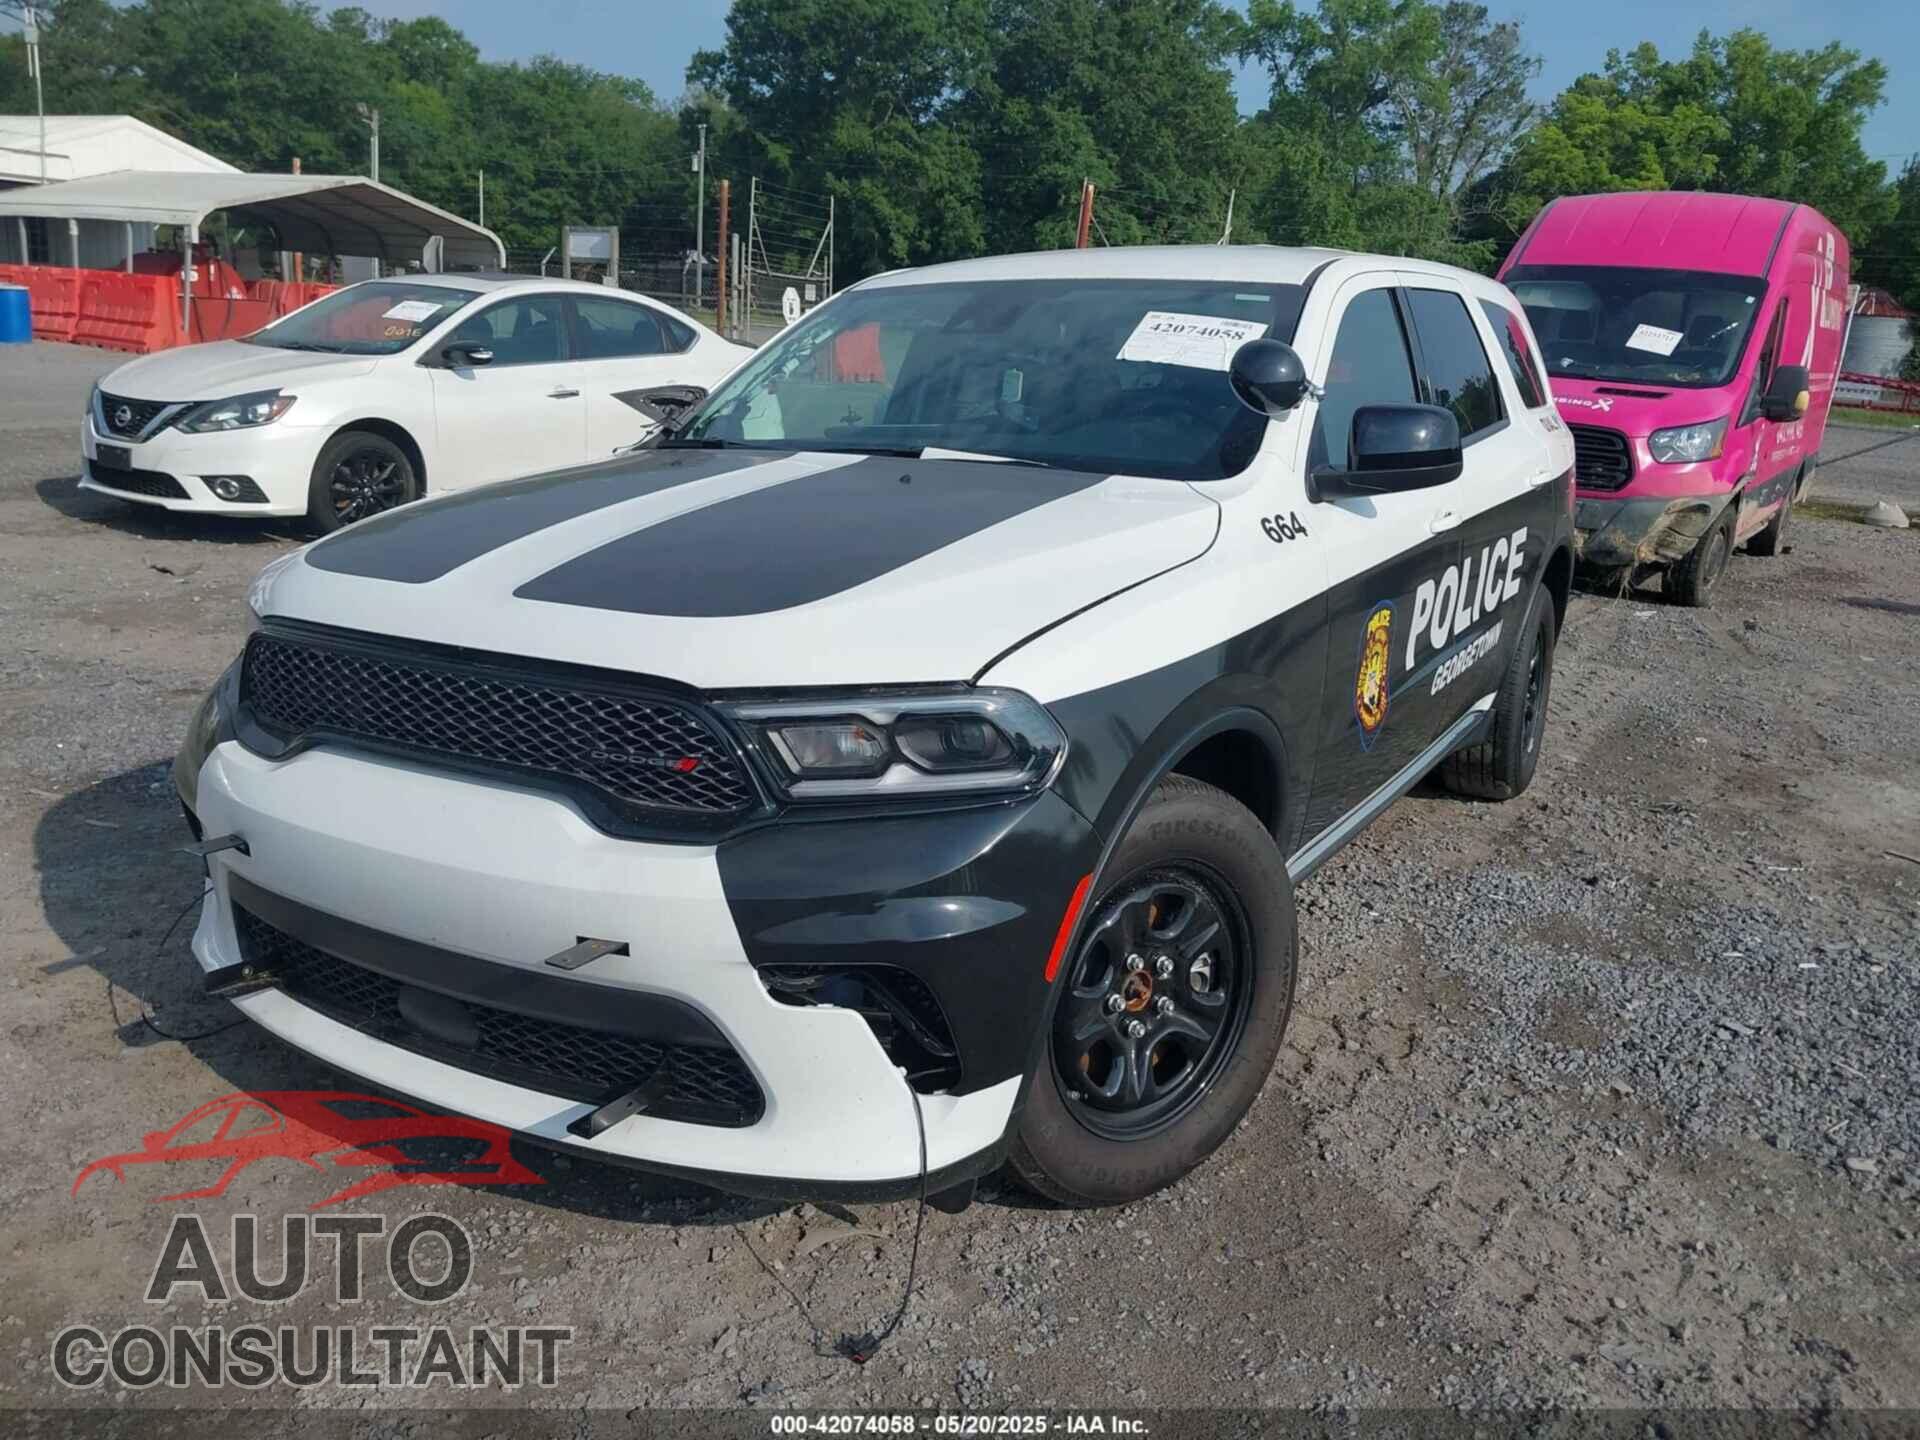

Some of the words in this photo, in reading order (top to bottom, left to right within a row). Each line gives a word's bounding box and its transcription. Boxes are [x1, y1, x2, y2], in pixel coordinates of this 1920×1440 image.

[1149, 321, 1246, 341] 42074058
[1260, 511, 1309, 543] 664
[1405, 526, 1528, 671] POLICE
[1430, 618, 1504, 696] GEORGETOWN
